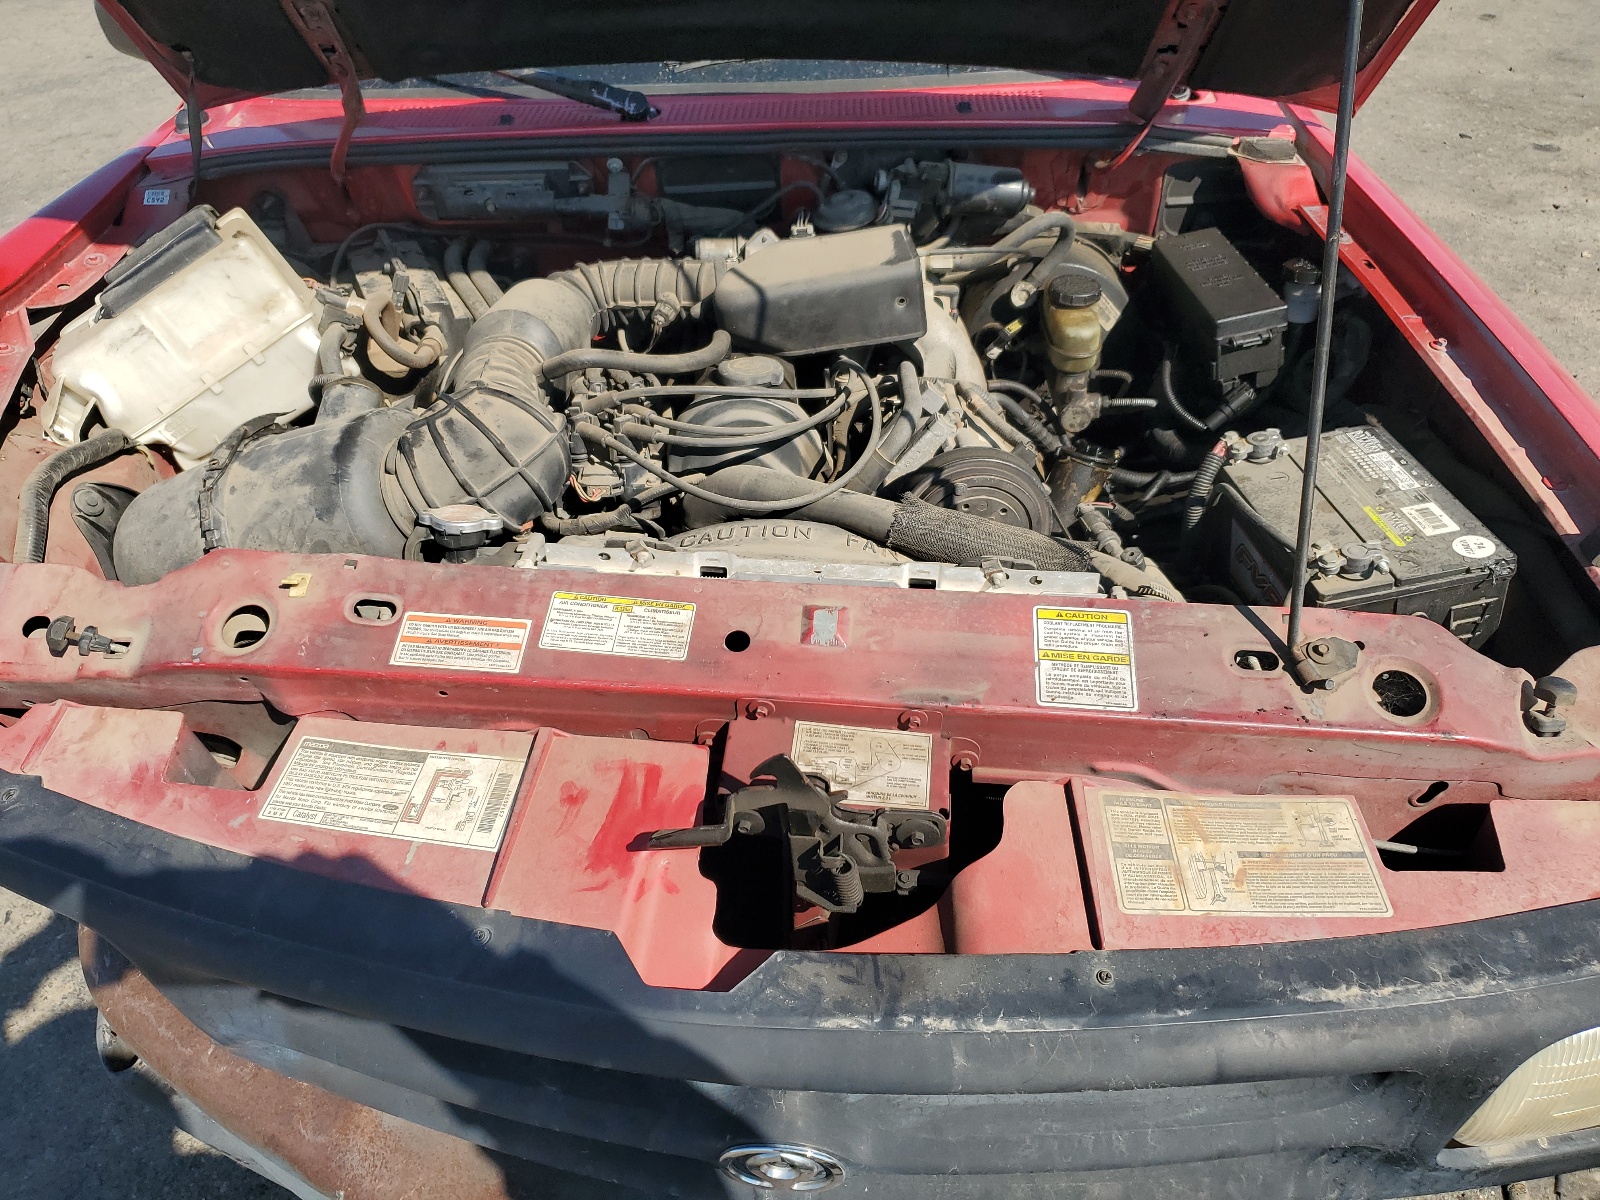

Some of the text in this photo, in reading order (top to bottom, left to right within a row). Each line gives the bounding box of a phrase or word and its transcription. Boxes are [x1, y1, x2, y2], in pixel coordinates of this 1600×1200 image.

[679, 524, 899, 561] CAUTION FAN
[570, 601, 609, 609] CONDITIONER
[453, 618, 488, 626] WARNING
[434, 639, 494, 647] AVERTISSEMENT
[292, 810, 317, 821] Catalyst
